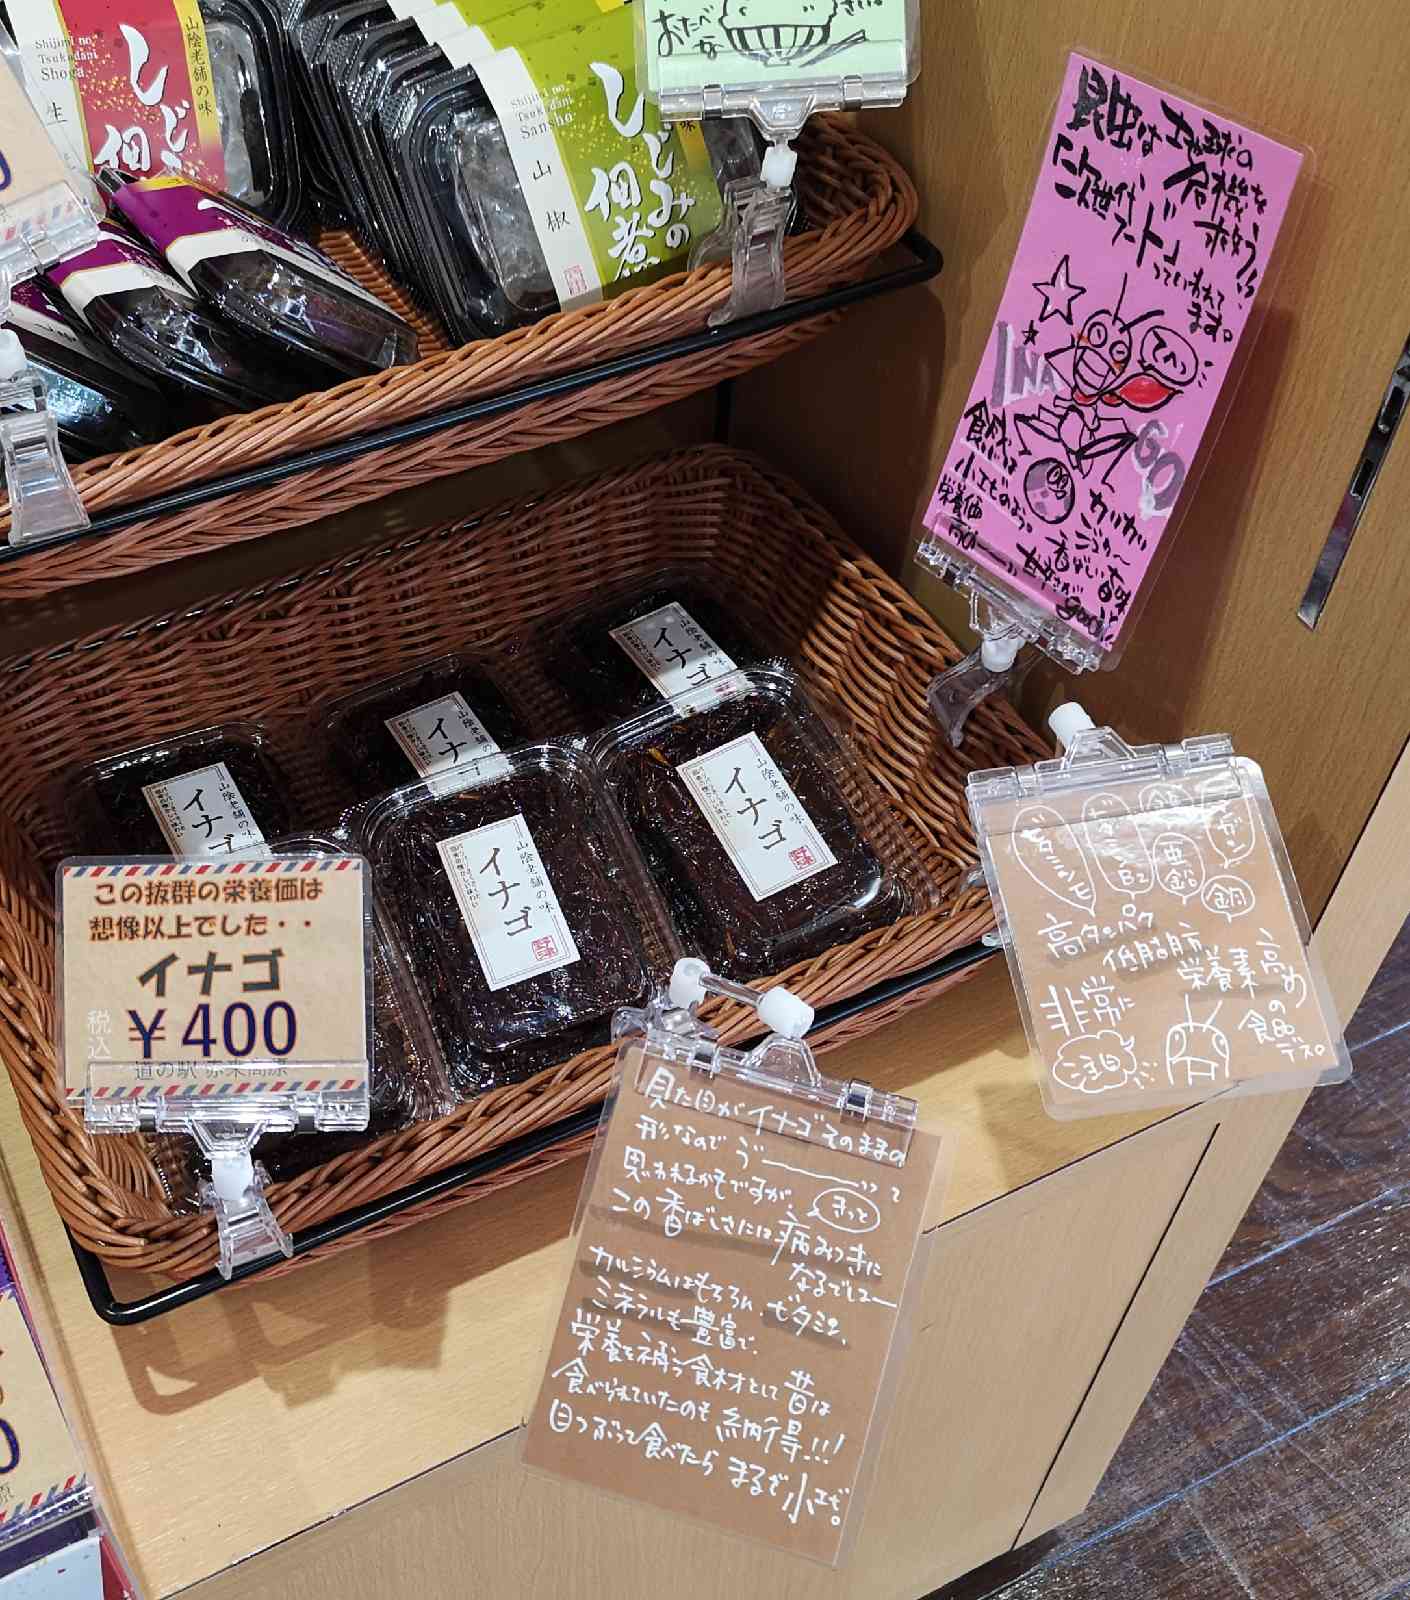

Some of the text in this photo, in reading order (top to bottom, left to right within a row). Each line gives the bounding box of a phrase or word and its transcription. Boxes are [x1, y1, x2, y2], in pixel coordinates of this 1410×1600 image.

[185, 17, 212, 116] 山陰老舗の味
[653, 627, 712, 686] イナゴ
[724, 767, 787, 850] イナゴ
[94, 878, 323, 906] この抜群の栄養価は
[480, 847, 533, 936] イナゴ
[137, 948, 285, 997] イナゴ
[87, 1010, 112, 1059] 税込
[1039, 975, 1136, 1035] 非常に
